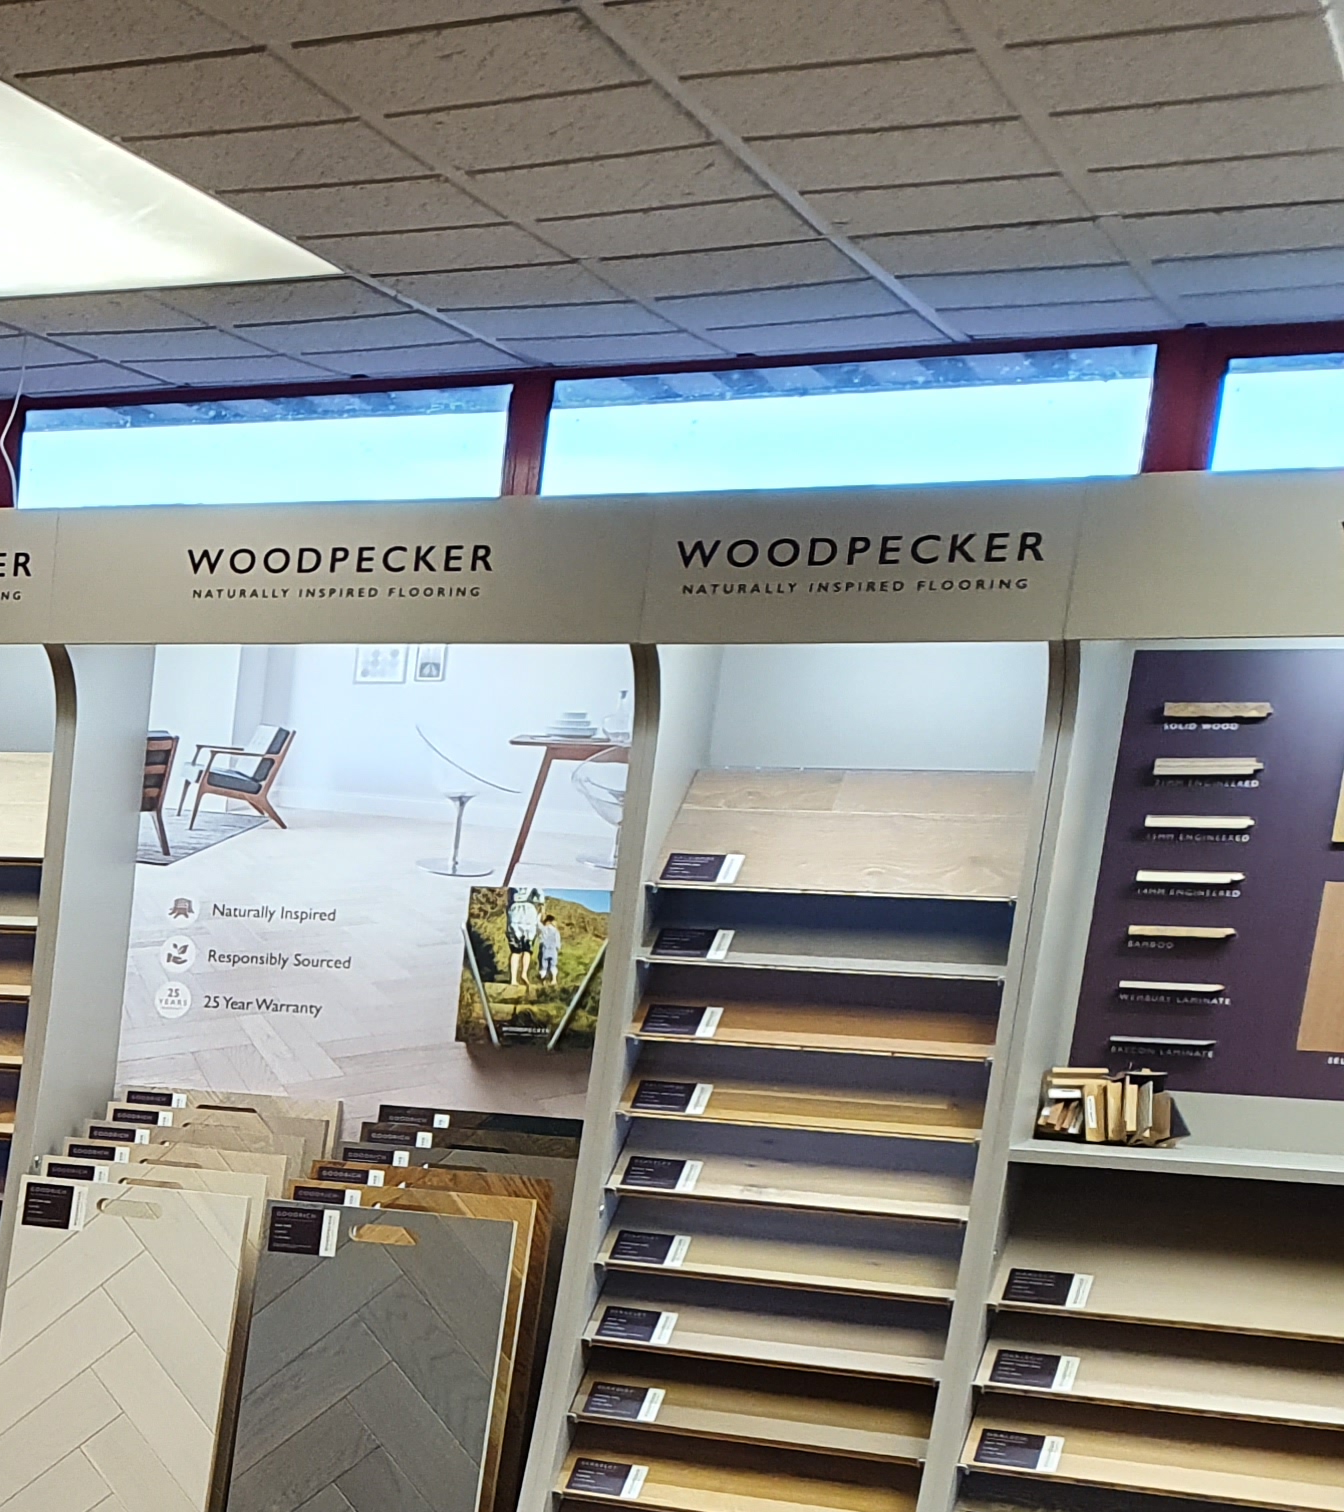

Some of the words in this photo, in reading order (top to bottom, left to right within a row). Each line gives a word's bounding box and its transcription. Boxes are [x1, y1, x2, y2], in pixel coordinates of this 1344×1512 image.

[677, 531, 1045, 569] WOODPECKER
[187, 544, 494, 575] WOODPECKER
[192, 587, 290, 599] NATURALLY
[298, 586, 379, 598] INSPIRED
[387, 586, 481, 598] FLOORING
[682, 583, 798, 595] NATURALLY
[808, 580, 905, 593] INSPIRED
[916, 578, 1029, 592] FLOORING
[1164, 722, 1198, 731] SOLID
[1200, 722, 1240, 731] WOOD
[1168, 888, 1241, 898] ENGINEERED
[212, 904, 276, 923] Naturally
[280, 906, 337, 924] Inspired
[208, 949, 289, 970] Responsibly
[293, 953, 352, 969] Sourced
[167, 988, 180, 998] 25
[159, 999, 188, 1007] YEARS
[204, 995, 220, 1009] 25
[223, 996, 253, 1011] Year
[255, 998, 323, 1018] Warranty
